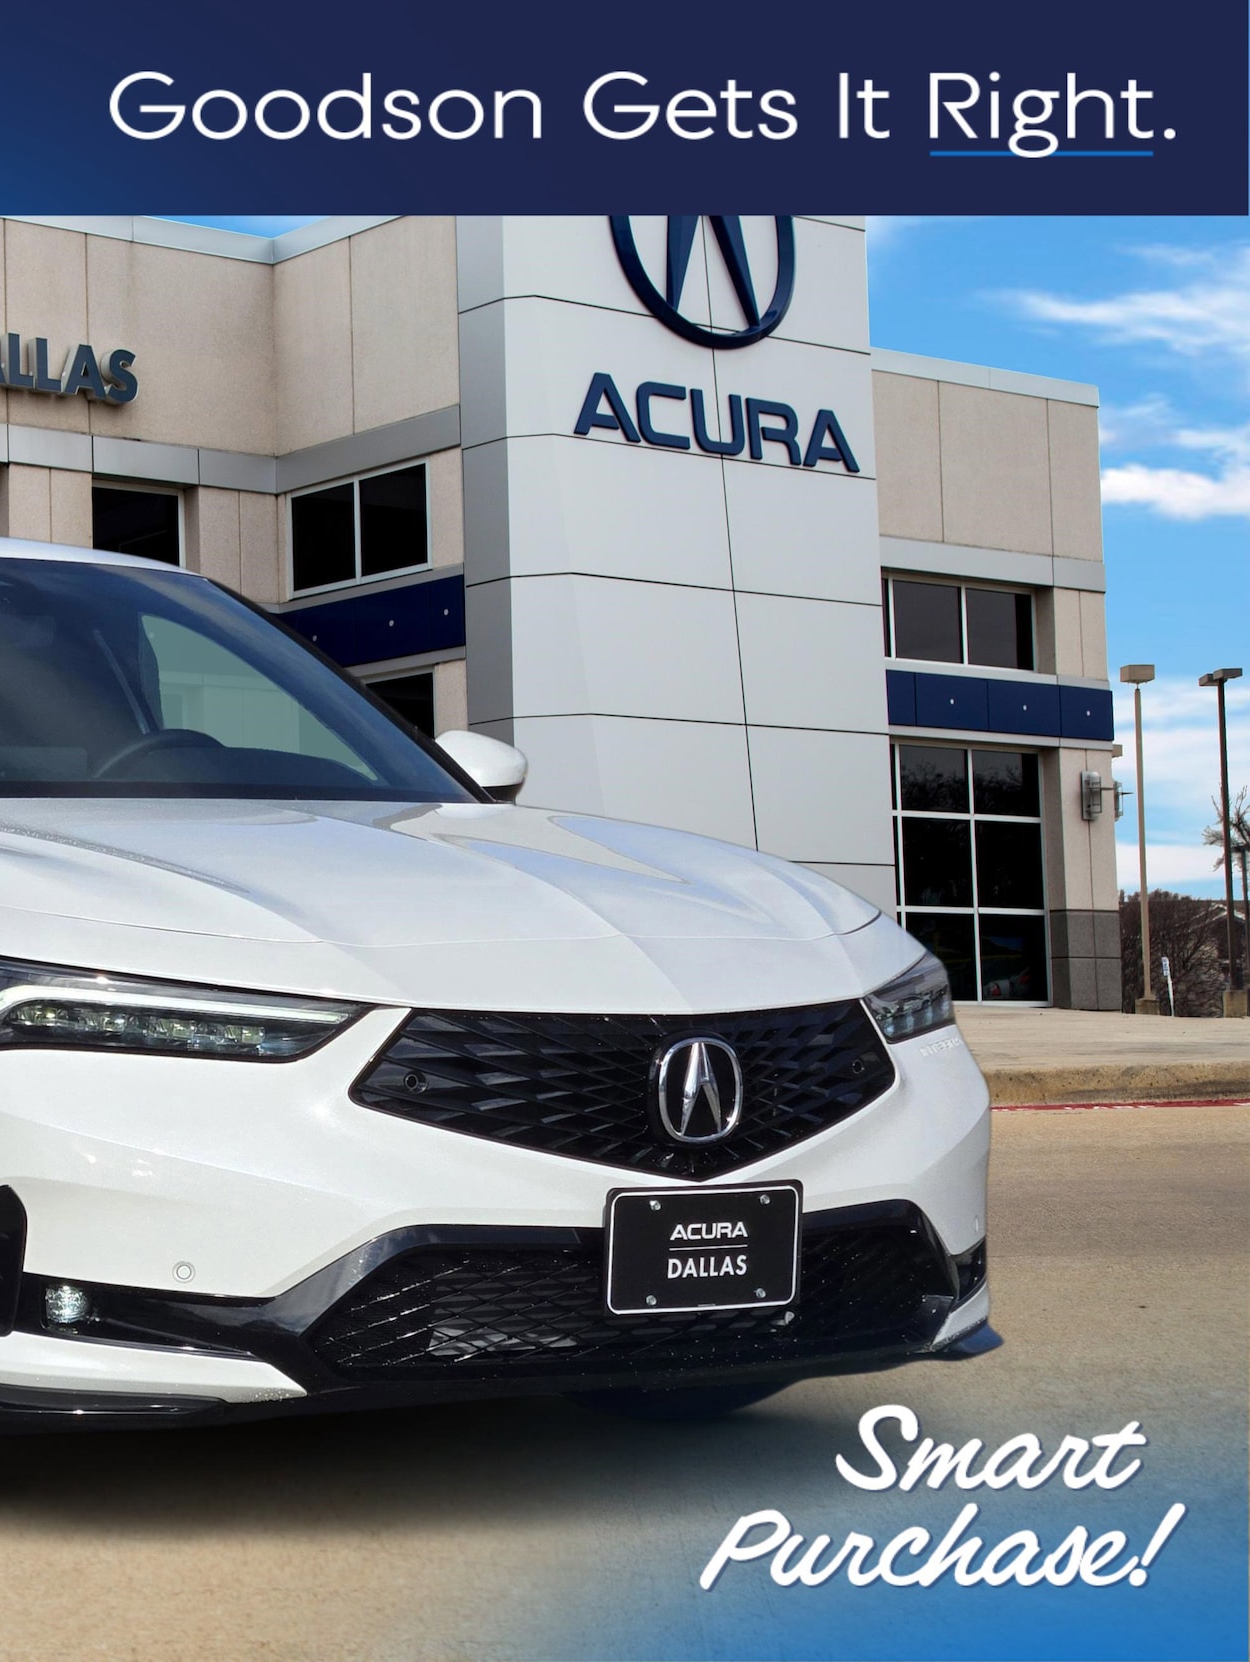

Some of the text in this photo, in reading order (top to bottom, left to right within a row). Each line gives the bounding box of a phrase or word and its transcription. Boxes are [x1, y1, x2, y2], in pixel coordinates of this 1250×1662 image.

[573, 372, 860, 473] ACURA
[669, 1221, 748, 1241] ACURA
[667, 1254, 748, 1279] DALLAS
